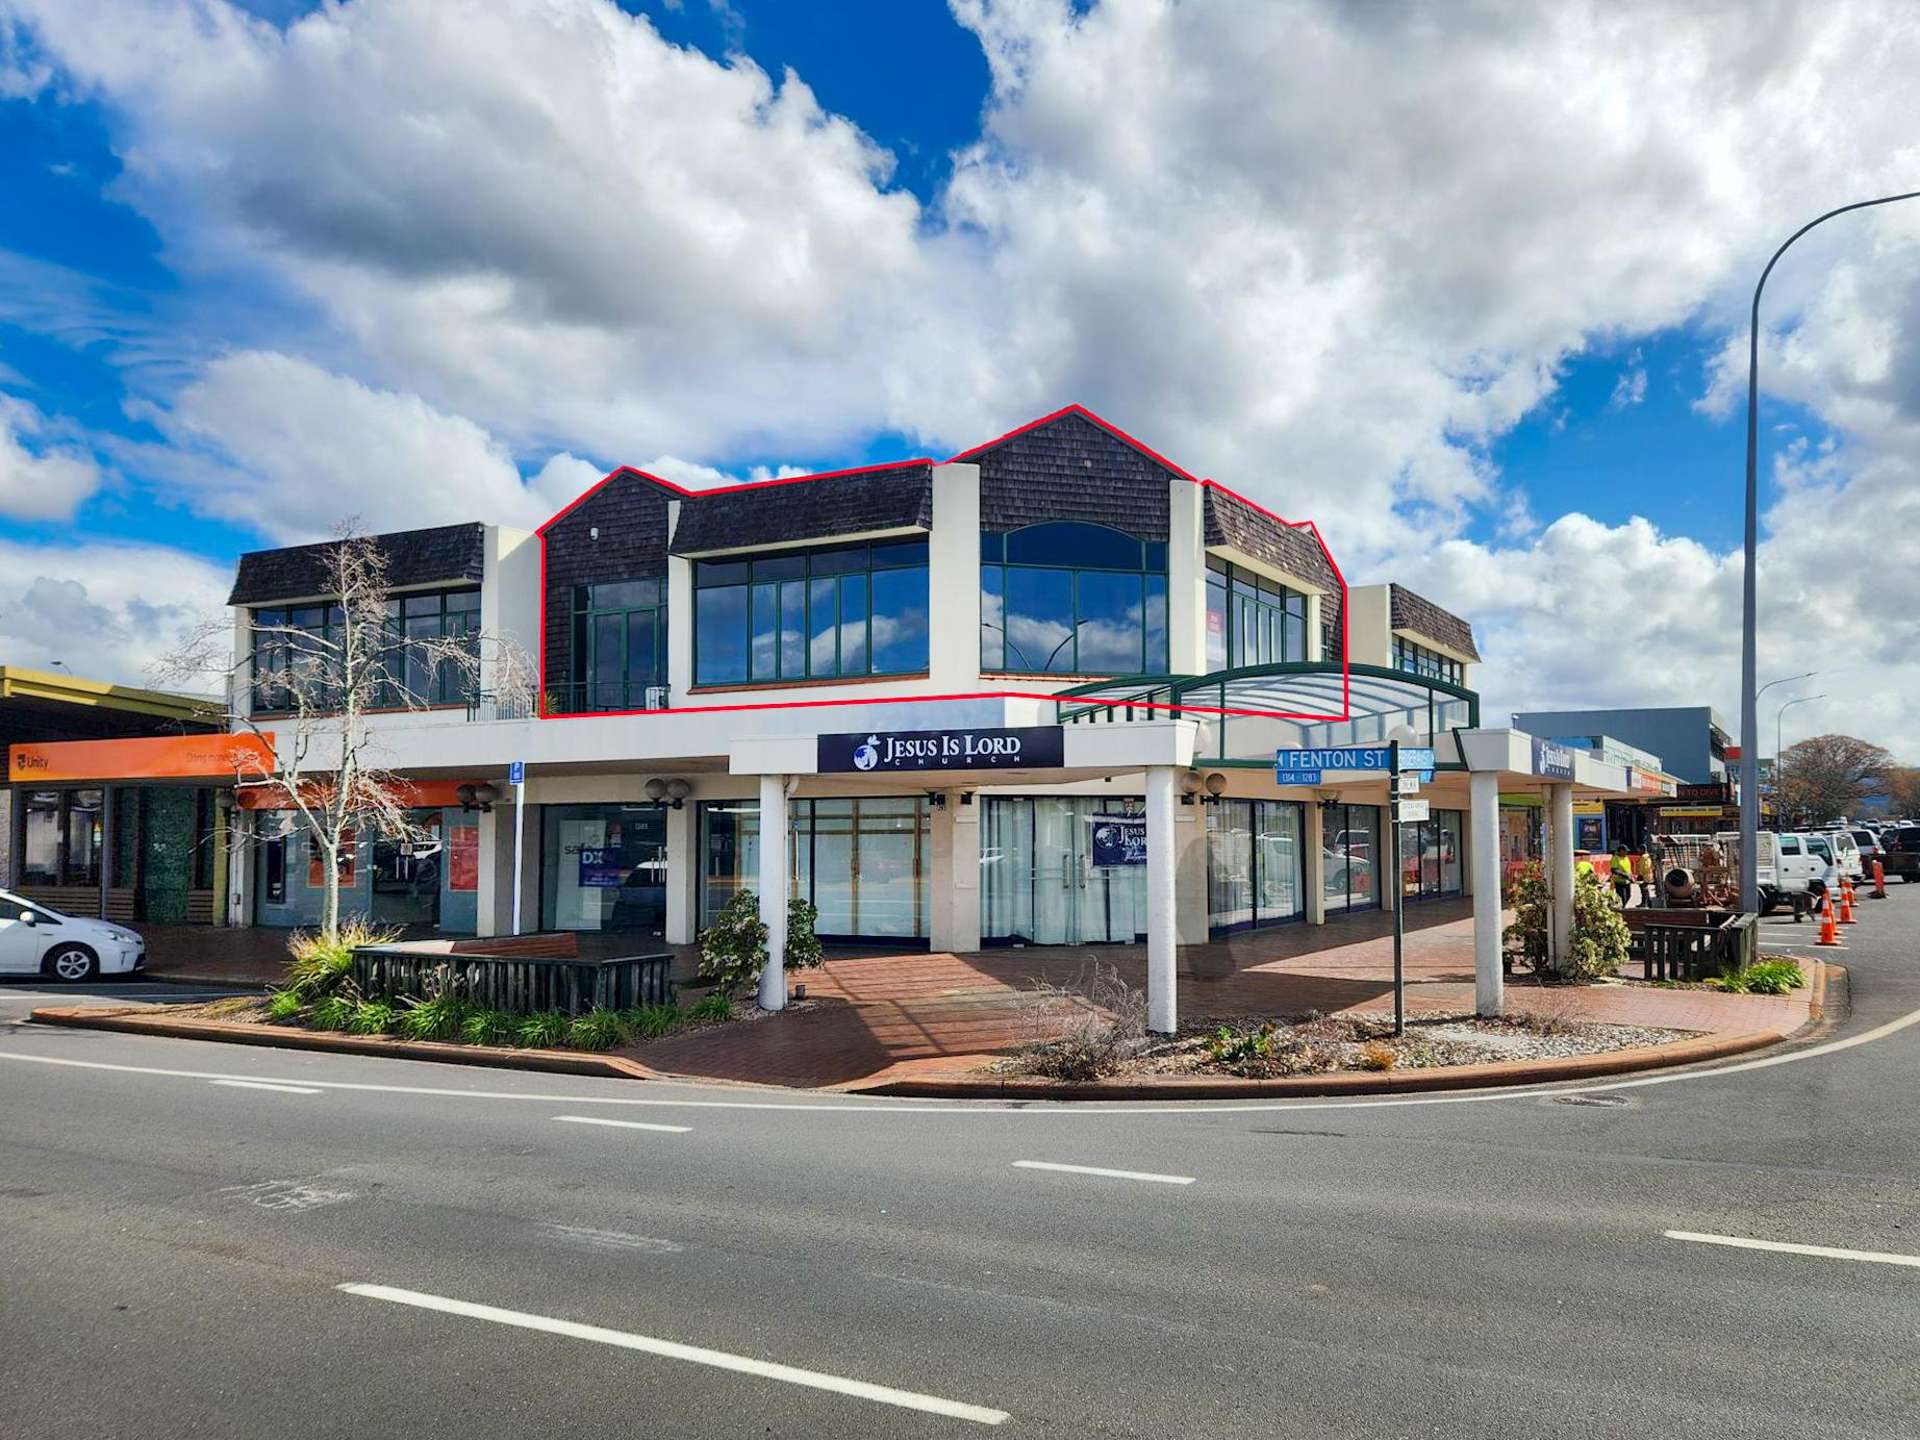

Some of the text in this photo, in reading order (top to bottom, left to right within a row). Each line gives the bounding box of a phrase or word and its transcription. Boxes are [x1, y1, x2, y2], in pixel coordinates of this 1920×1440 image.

[884, 734, 1021, 763] JESUS IS LORD
[895, 756, 1020, 766] CHURCH
[1289, 751, 1356, 768] FENTON
[1363, 750, 1385, 767] ST
